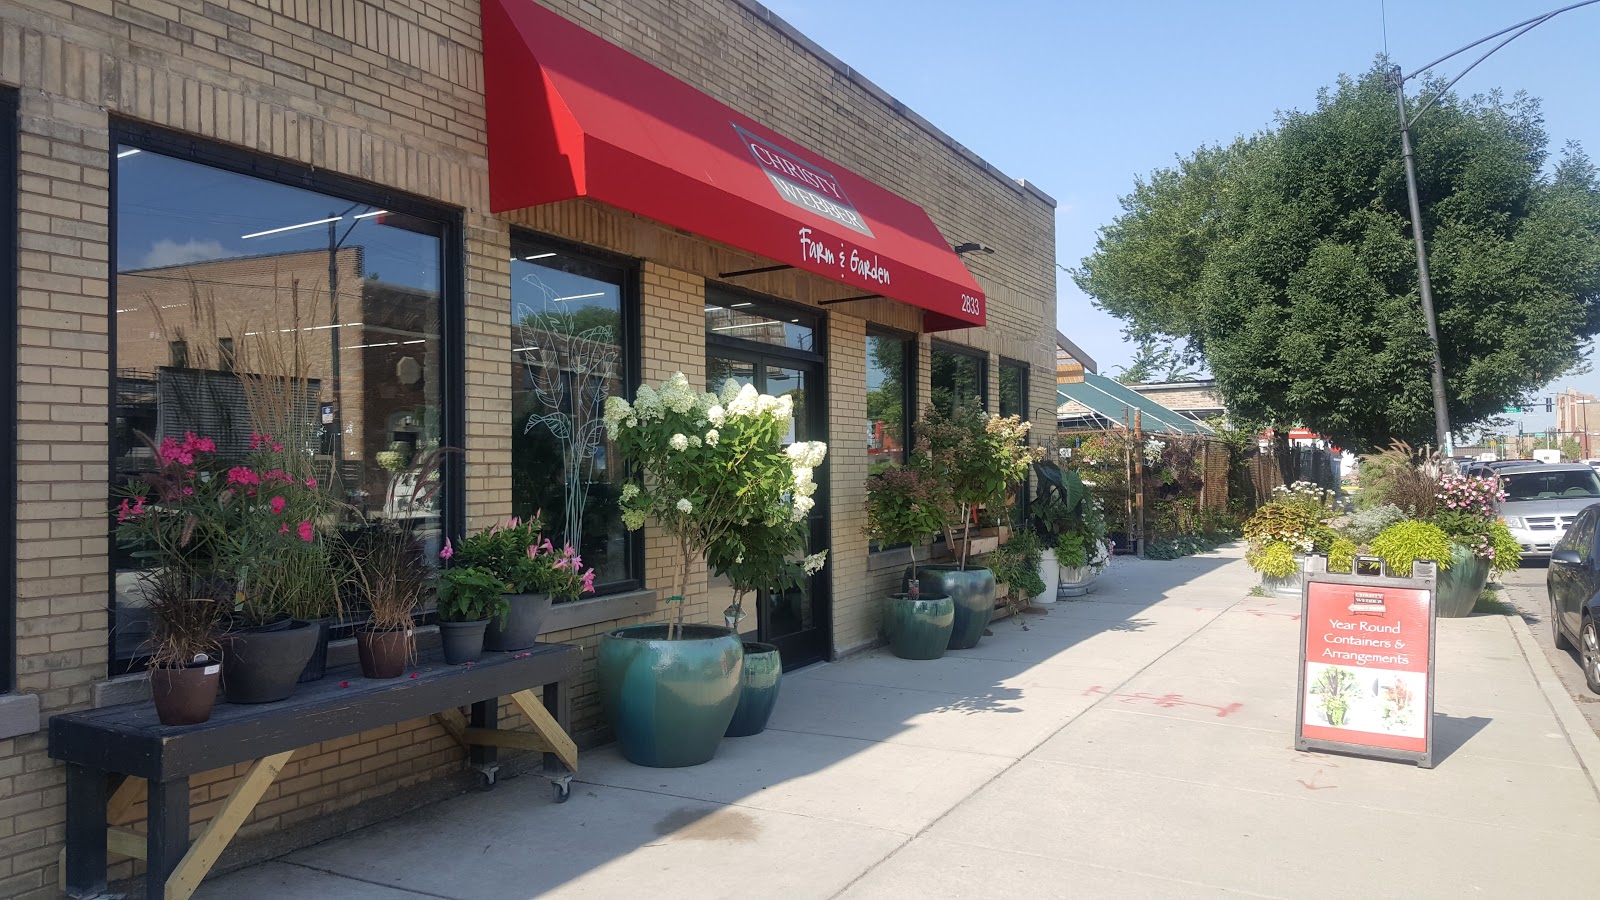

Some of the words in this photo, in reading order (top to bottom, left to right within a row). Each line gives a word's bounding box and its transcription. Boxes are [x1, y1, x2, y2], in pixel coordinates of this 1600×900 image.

[750, 143, 842, 199] CHRISTY
[772, 175, 866, 230] WEBBER
[961, 293, 980, 316] 2833
[1329, 618, 1357, 630] Year
[1360, 621, 1401, 634] Round
[1324, 633, 1391, 648] Containers
[1394, 640, 1406, 649] &
[1322, 648, 1410, 665] Arrangements
